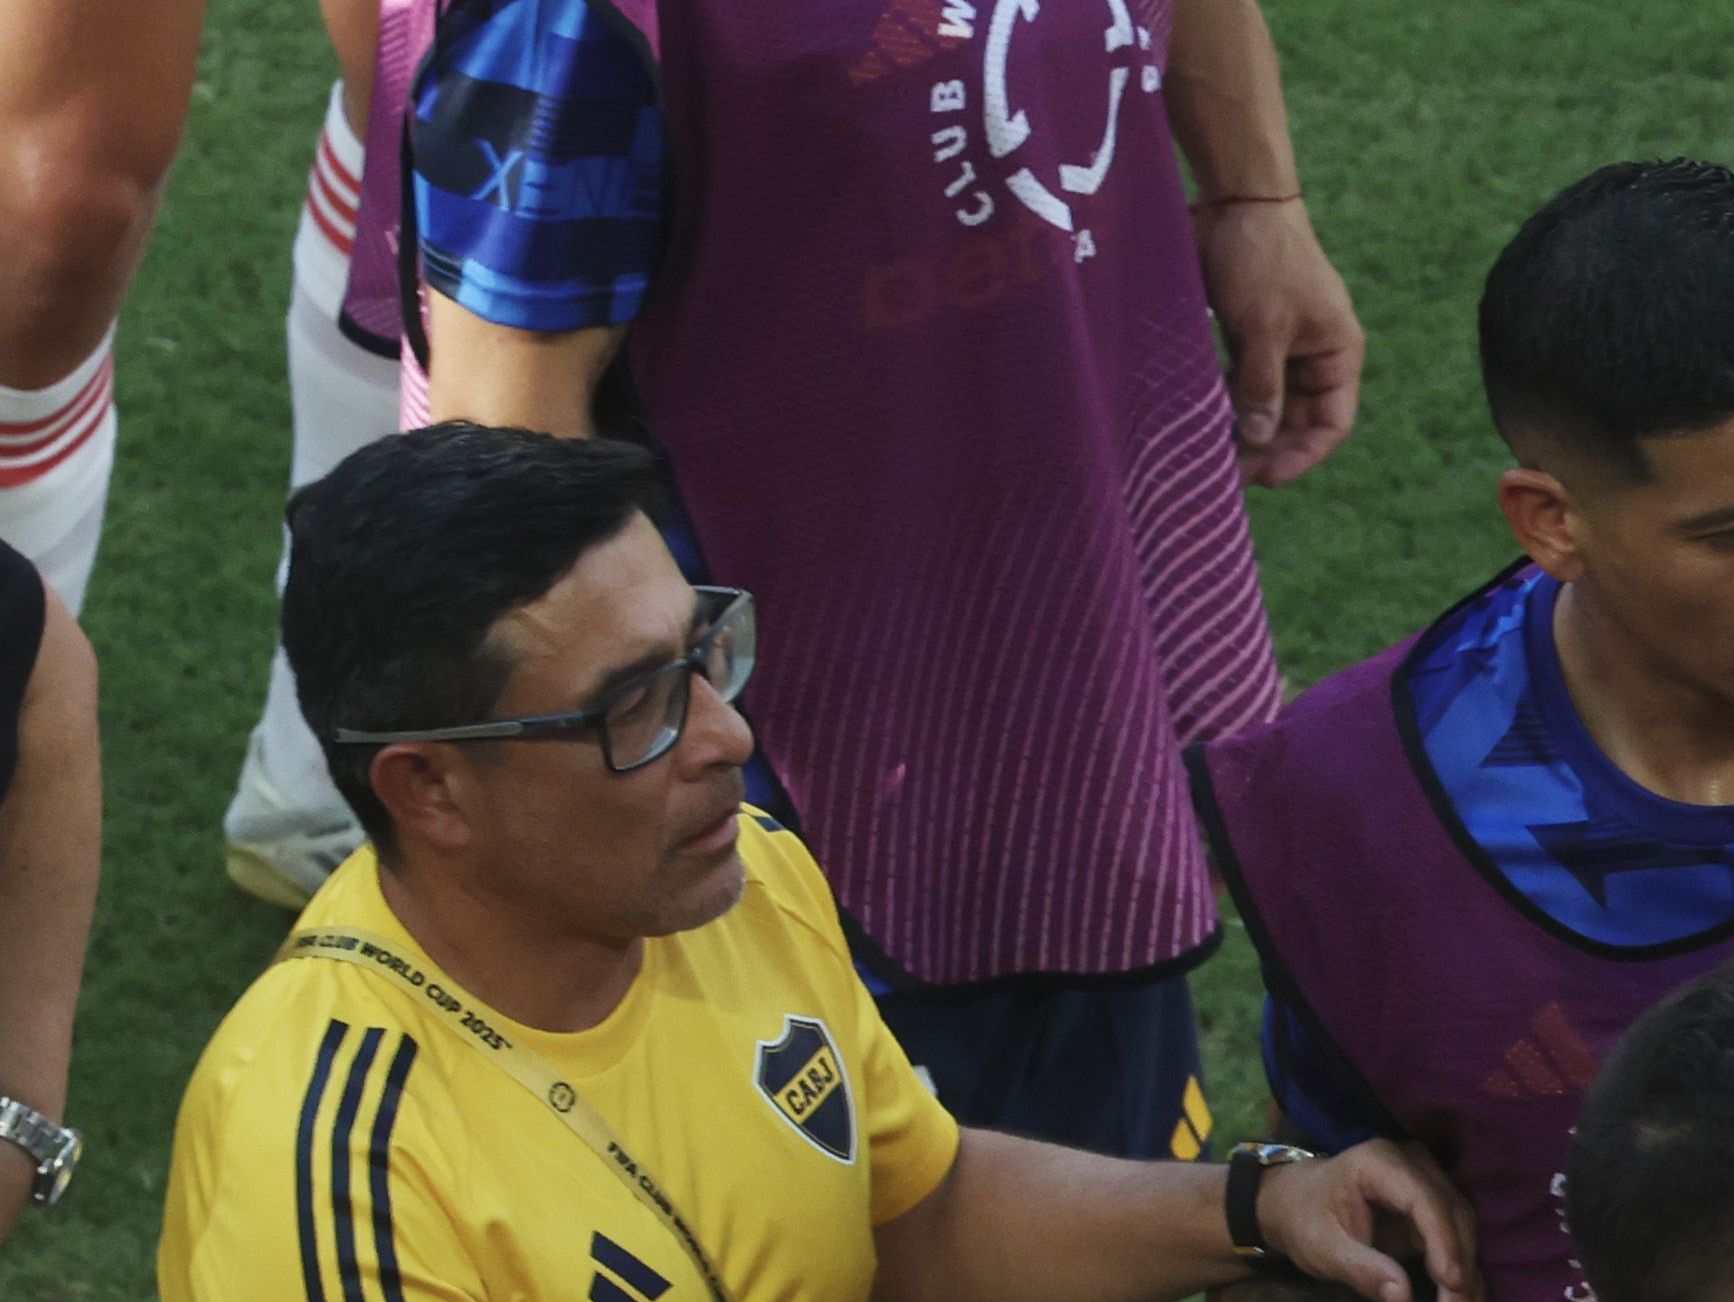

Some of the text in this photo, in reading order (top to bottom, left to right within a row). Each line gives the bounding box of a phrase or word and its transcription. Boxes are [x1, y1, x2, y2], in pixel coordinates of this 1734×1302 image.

[930, 79, 995, 226] CLUB
[360, 942, 425, 986] WORLD
[426, 984, 461, 1013] CUP
[786, 1057, 834, 1116] CABJ
